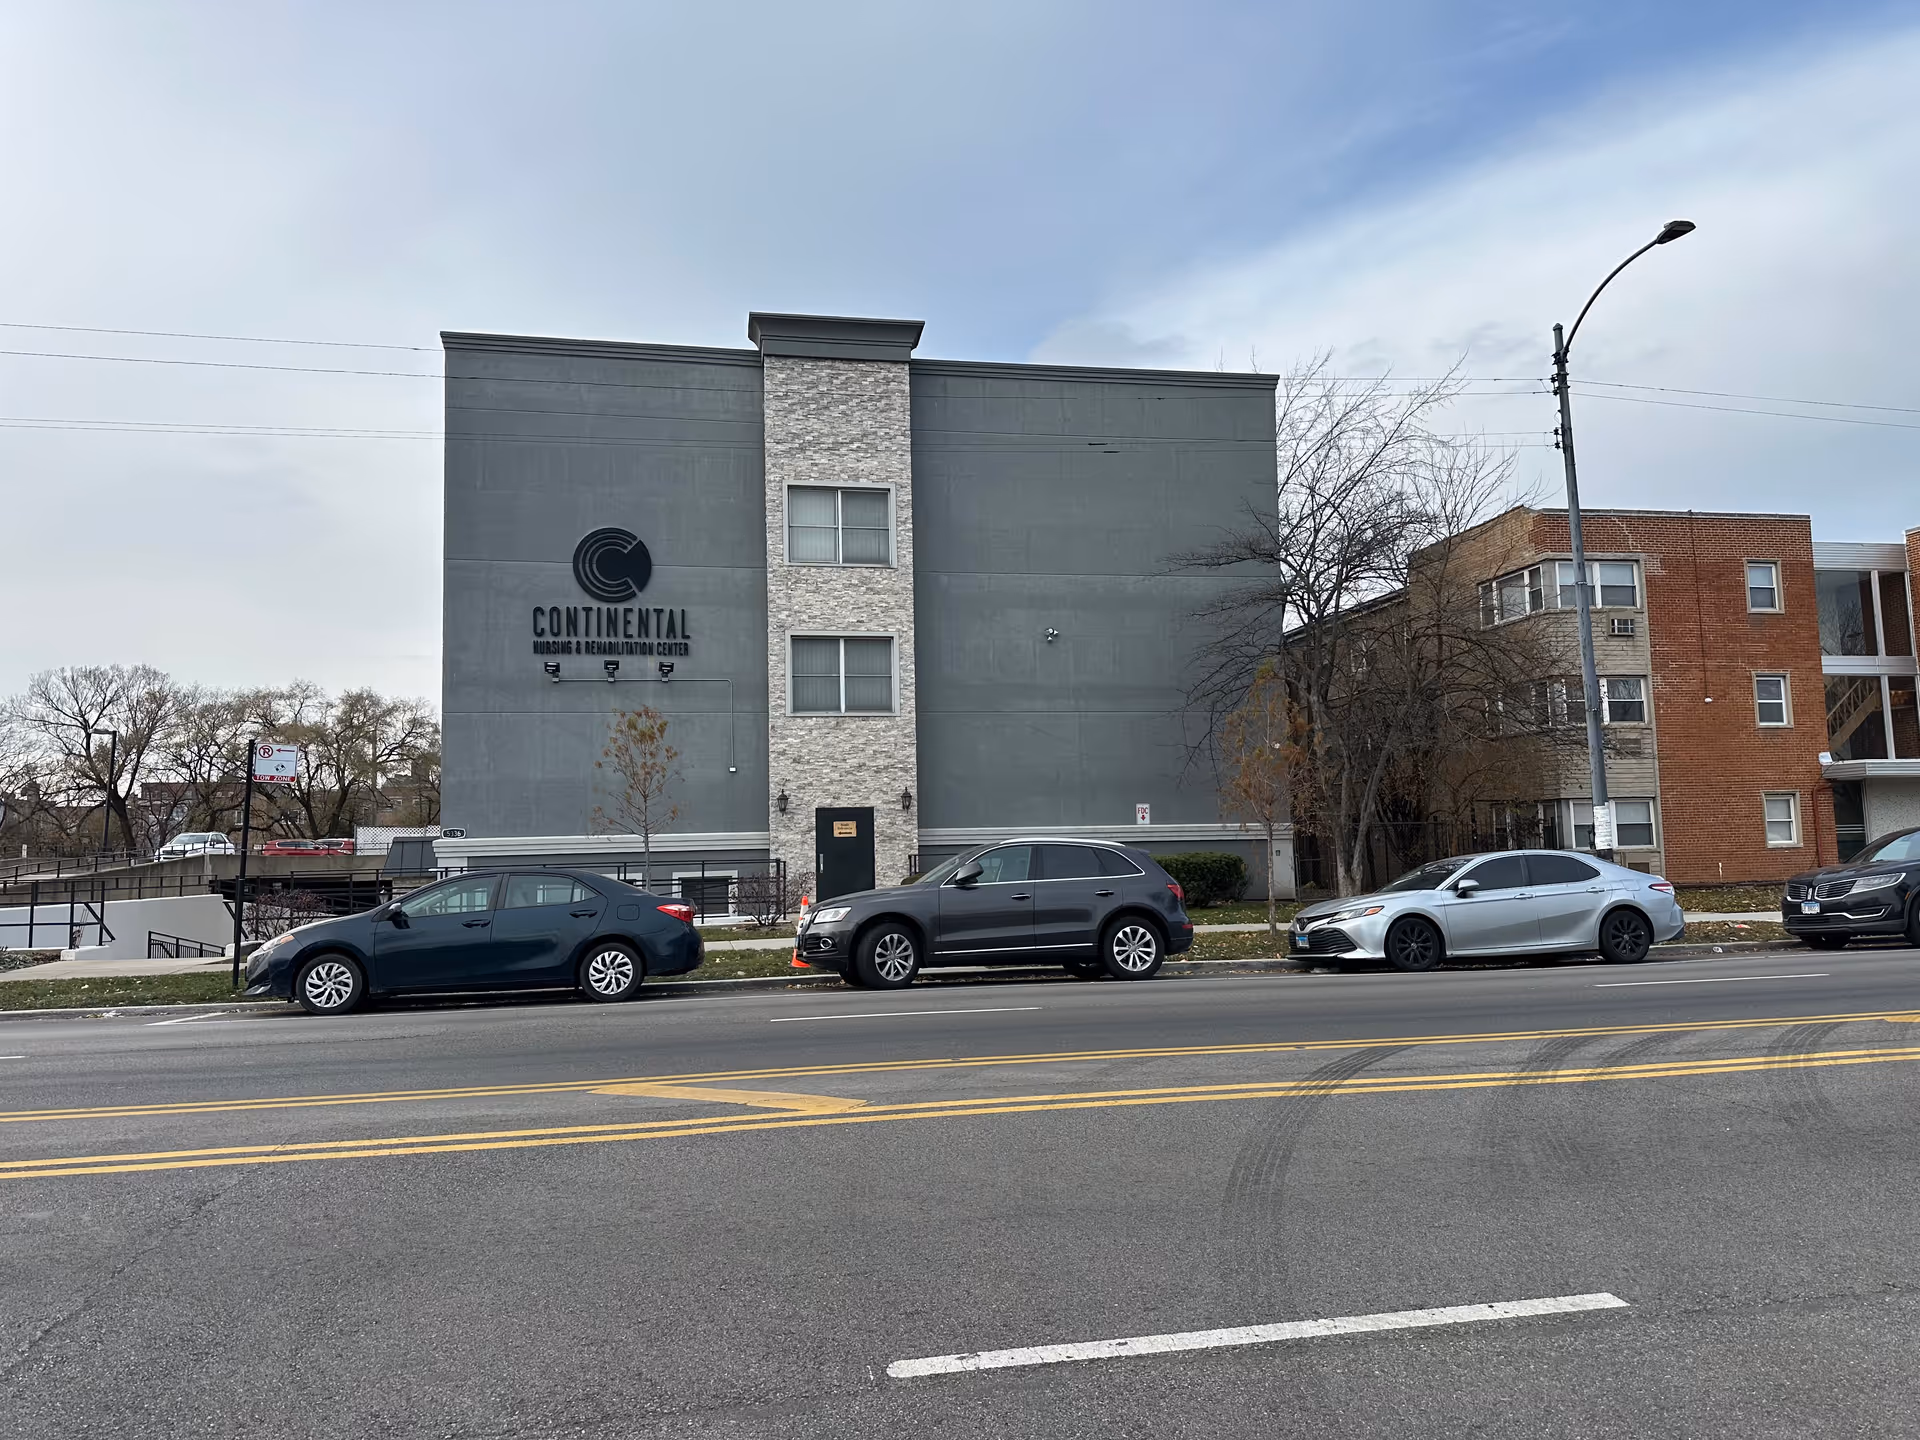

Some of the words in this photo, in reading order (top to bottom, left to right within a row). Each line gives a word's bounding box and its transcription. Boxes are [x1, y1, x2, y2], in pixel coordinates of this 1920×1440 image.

[533, 606, 690, 639] CONTINENTAL
[533, 640, 572, 655] NURSING
[575, 640, 581, 655] &
[585, 641, 653, 656] REHABILITATION
[656, 642, 689, 656] CENTER
